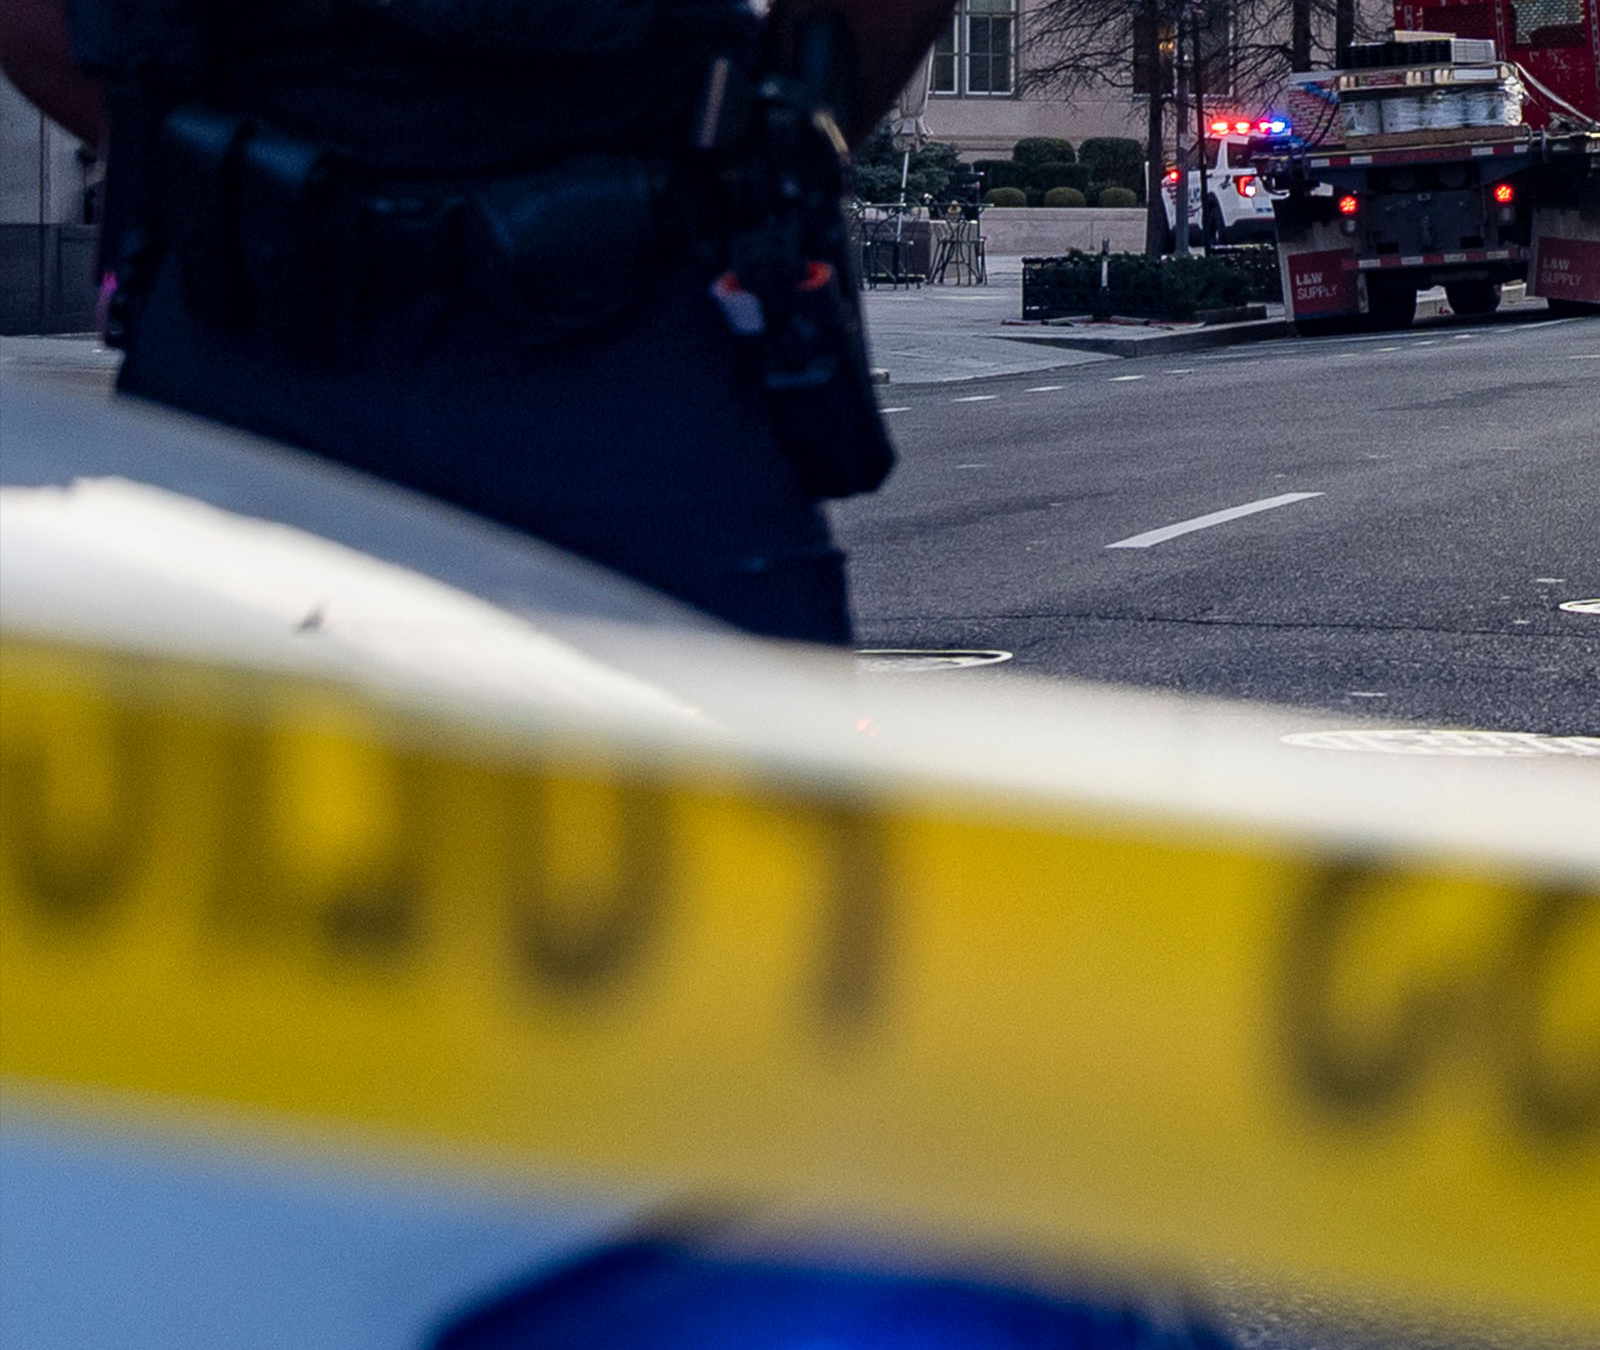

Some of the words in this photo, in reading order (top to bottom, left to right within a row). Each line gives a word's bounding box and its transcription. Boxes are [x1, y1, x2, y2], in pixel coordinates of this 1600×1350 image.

[1295, 271, 1323, 286] L&W
[1541, 270, 1583, 287] SUPPLY
[1297, 284, 1338, 300] SUPPLY
